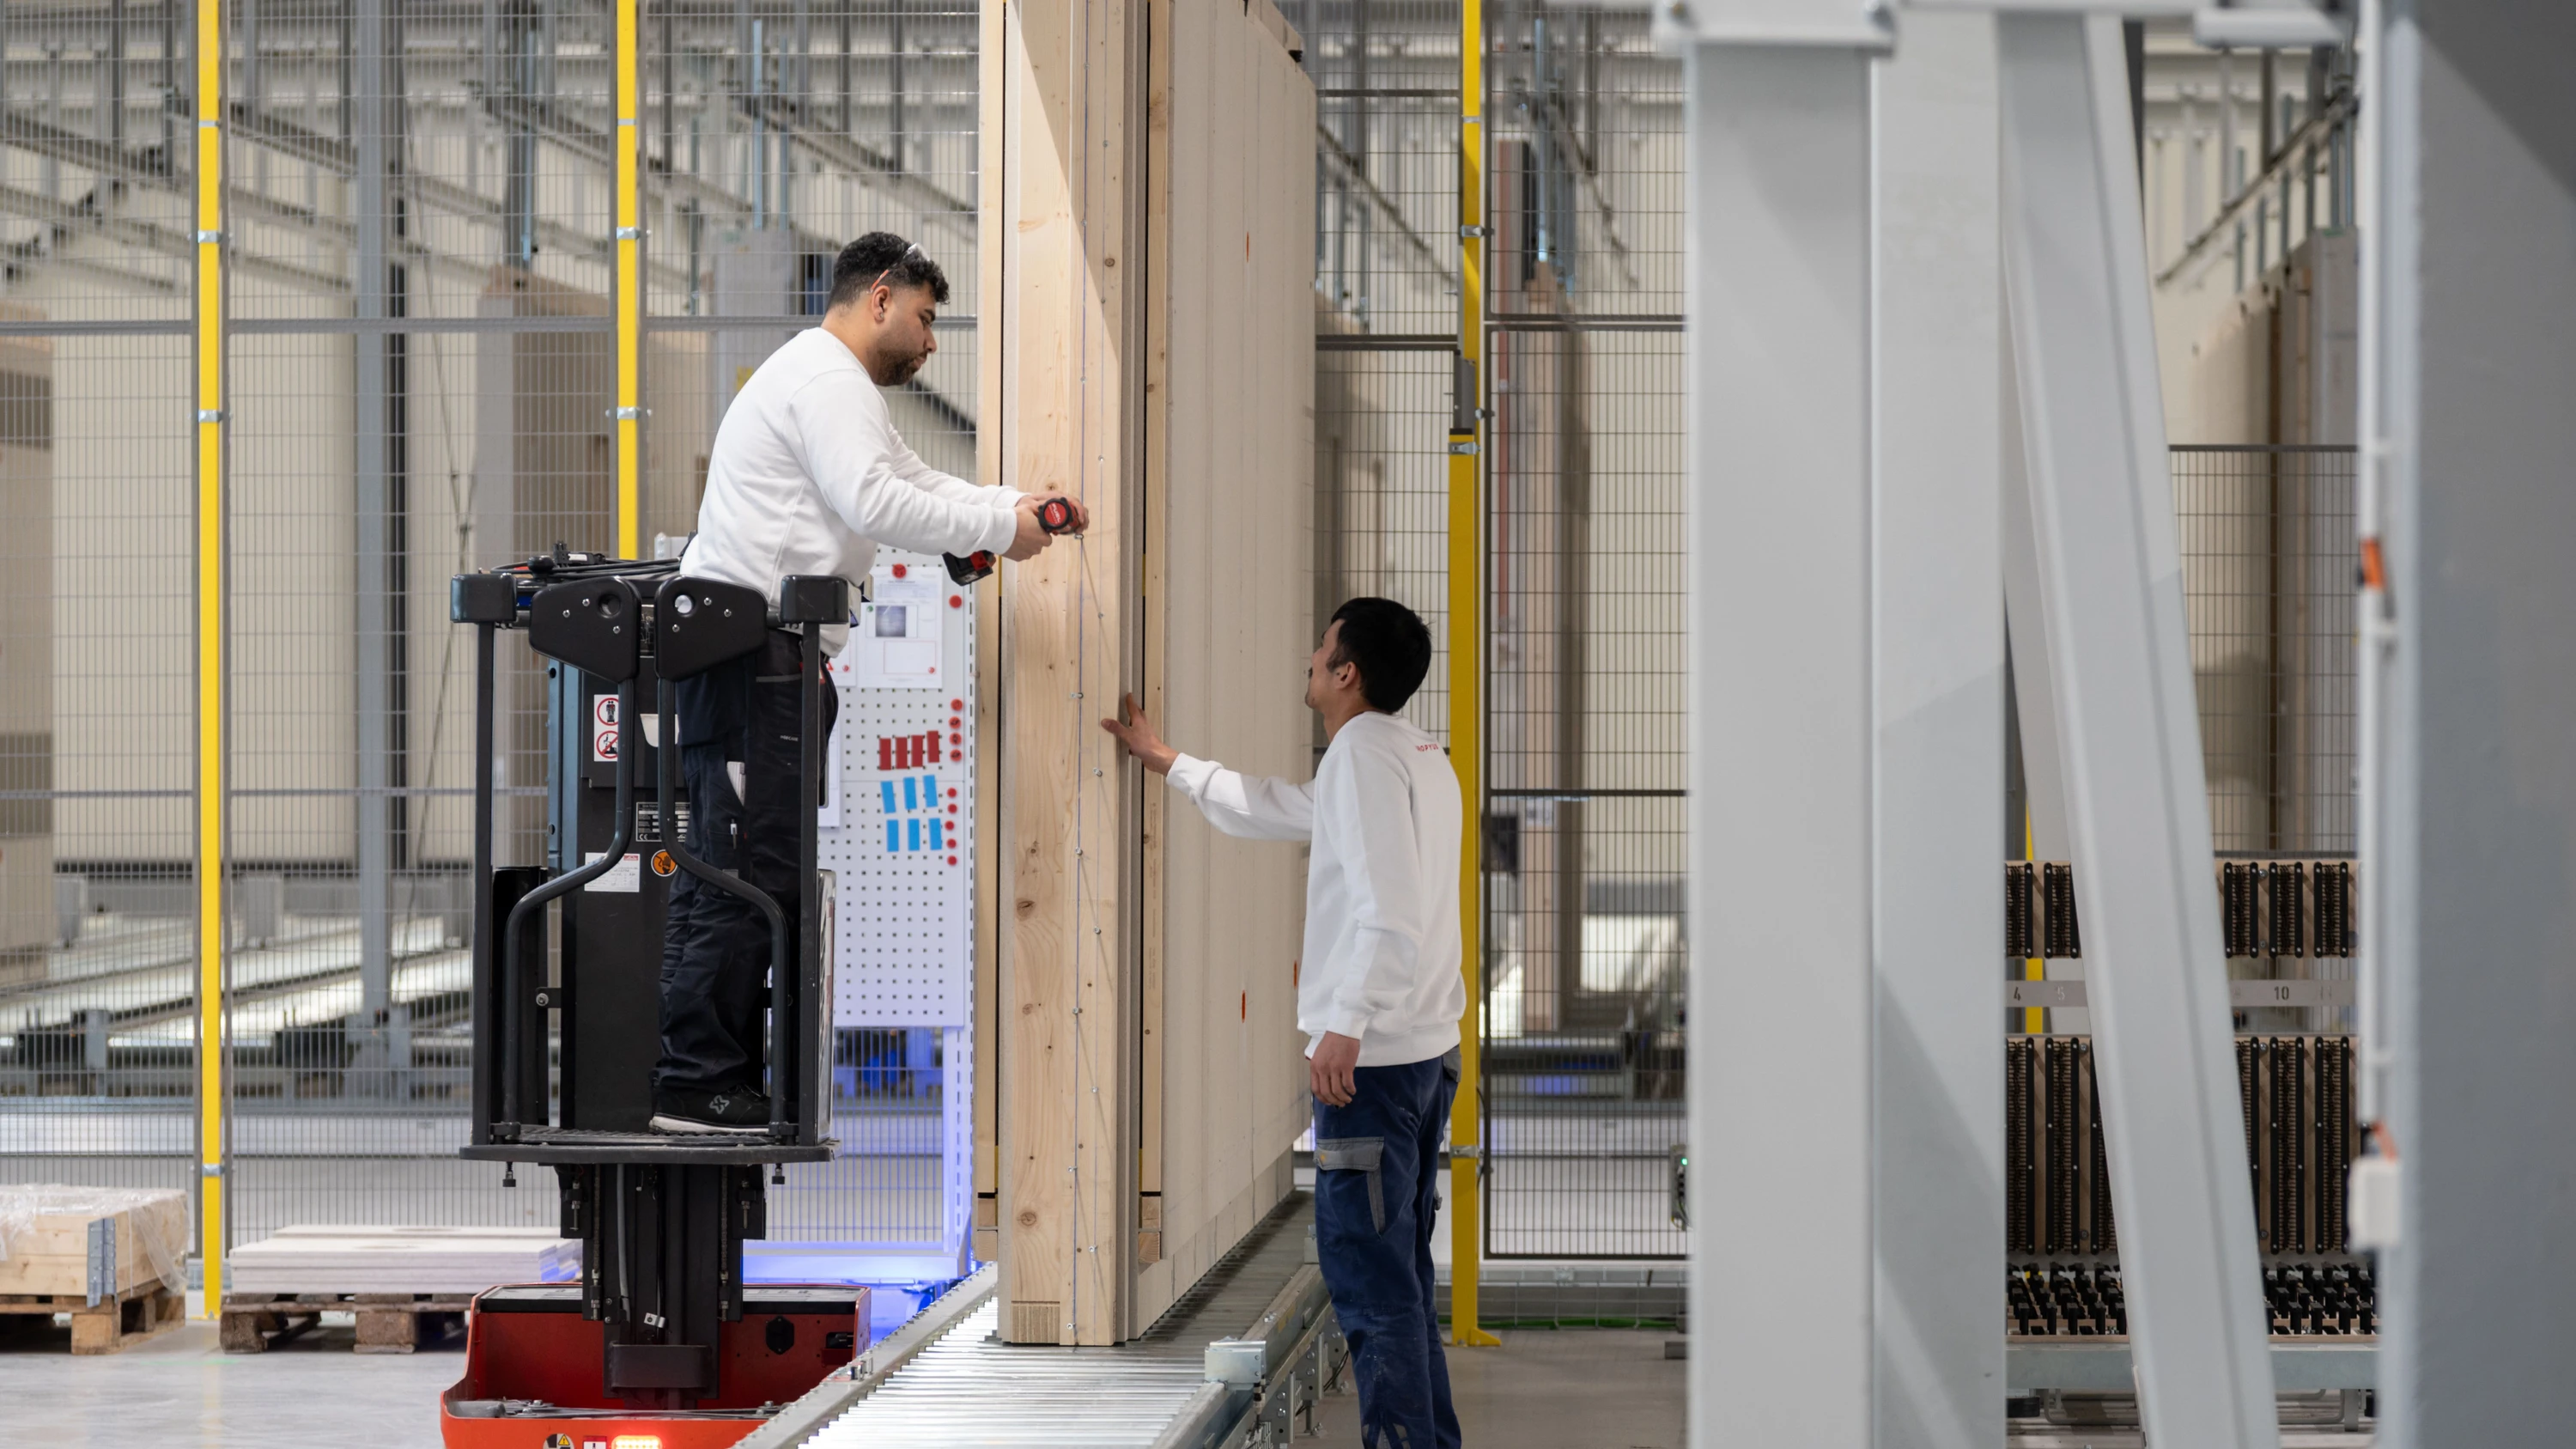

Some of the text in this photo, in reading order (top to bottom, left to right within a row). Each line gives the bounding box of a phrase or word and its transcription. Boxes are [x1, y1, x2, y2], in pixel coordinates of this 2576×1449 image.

[2013, 986, 2021, 1002] 4
[2057, 985, 2066, 1001] 5
[2274, 985, 2290, 1001] 10
